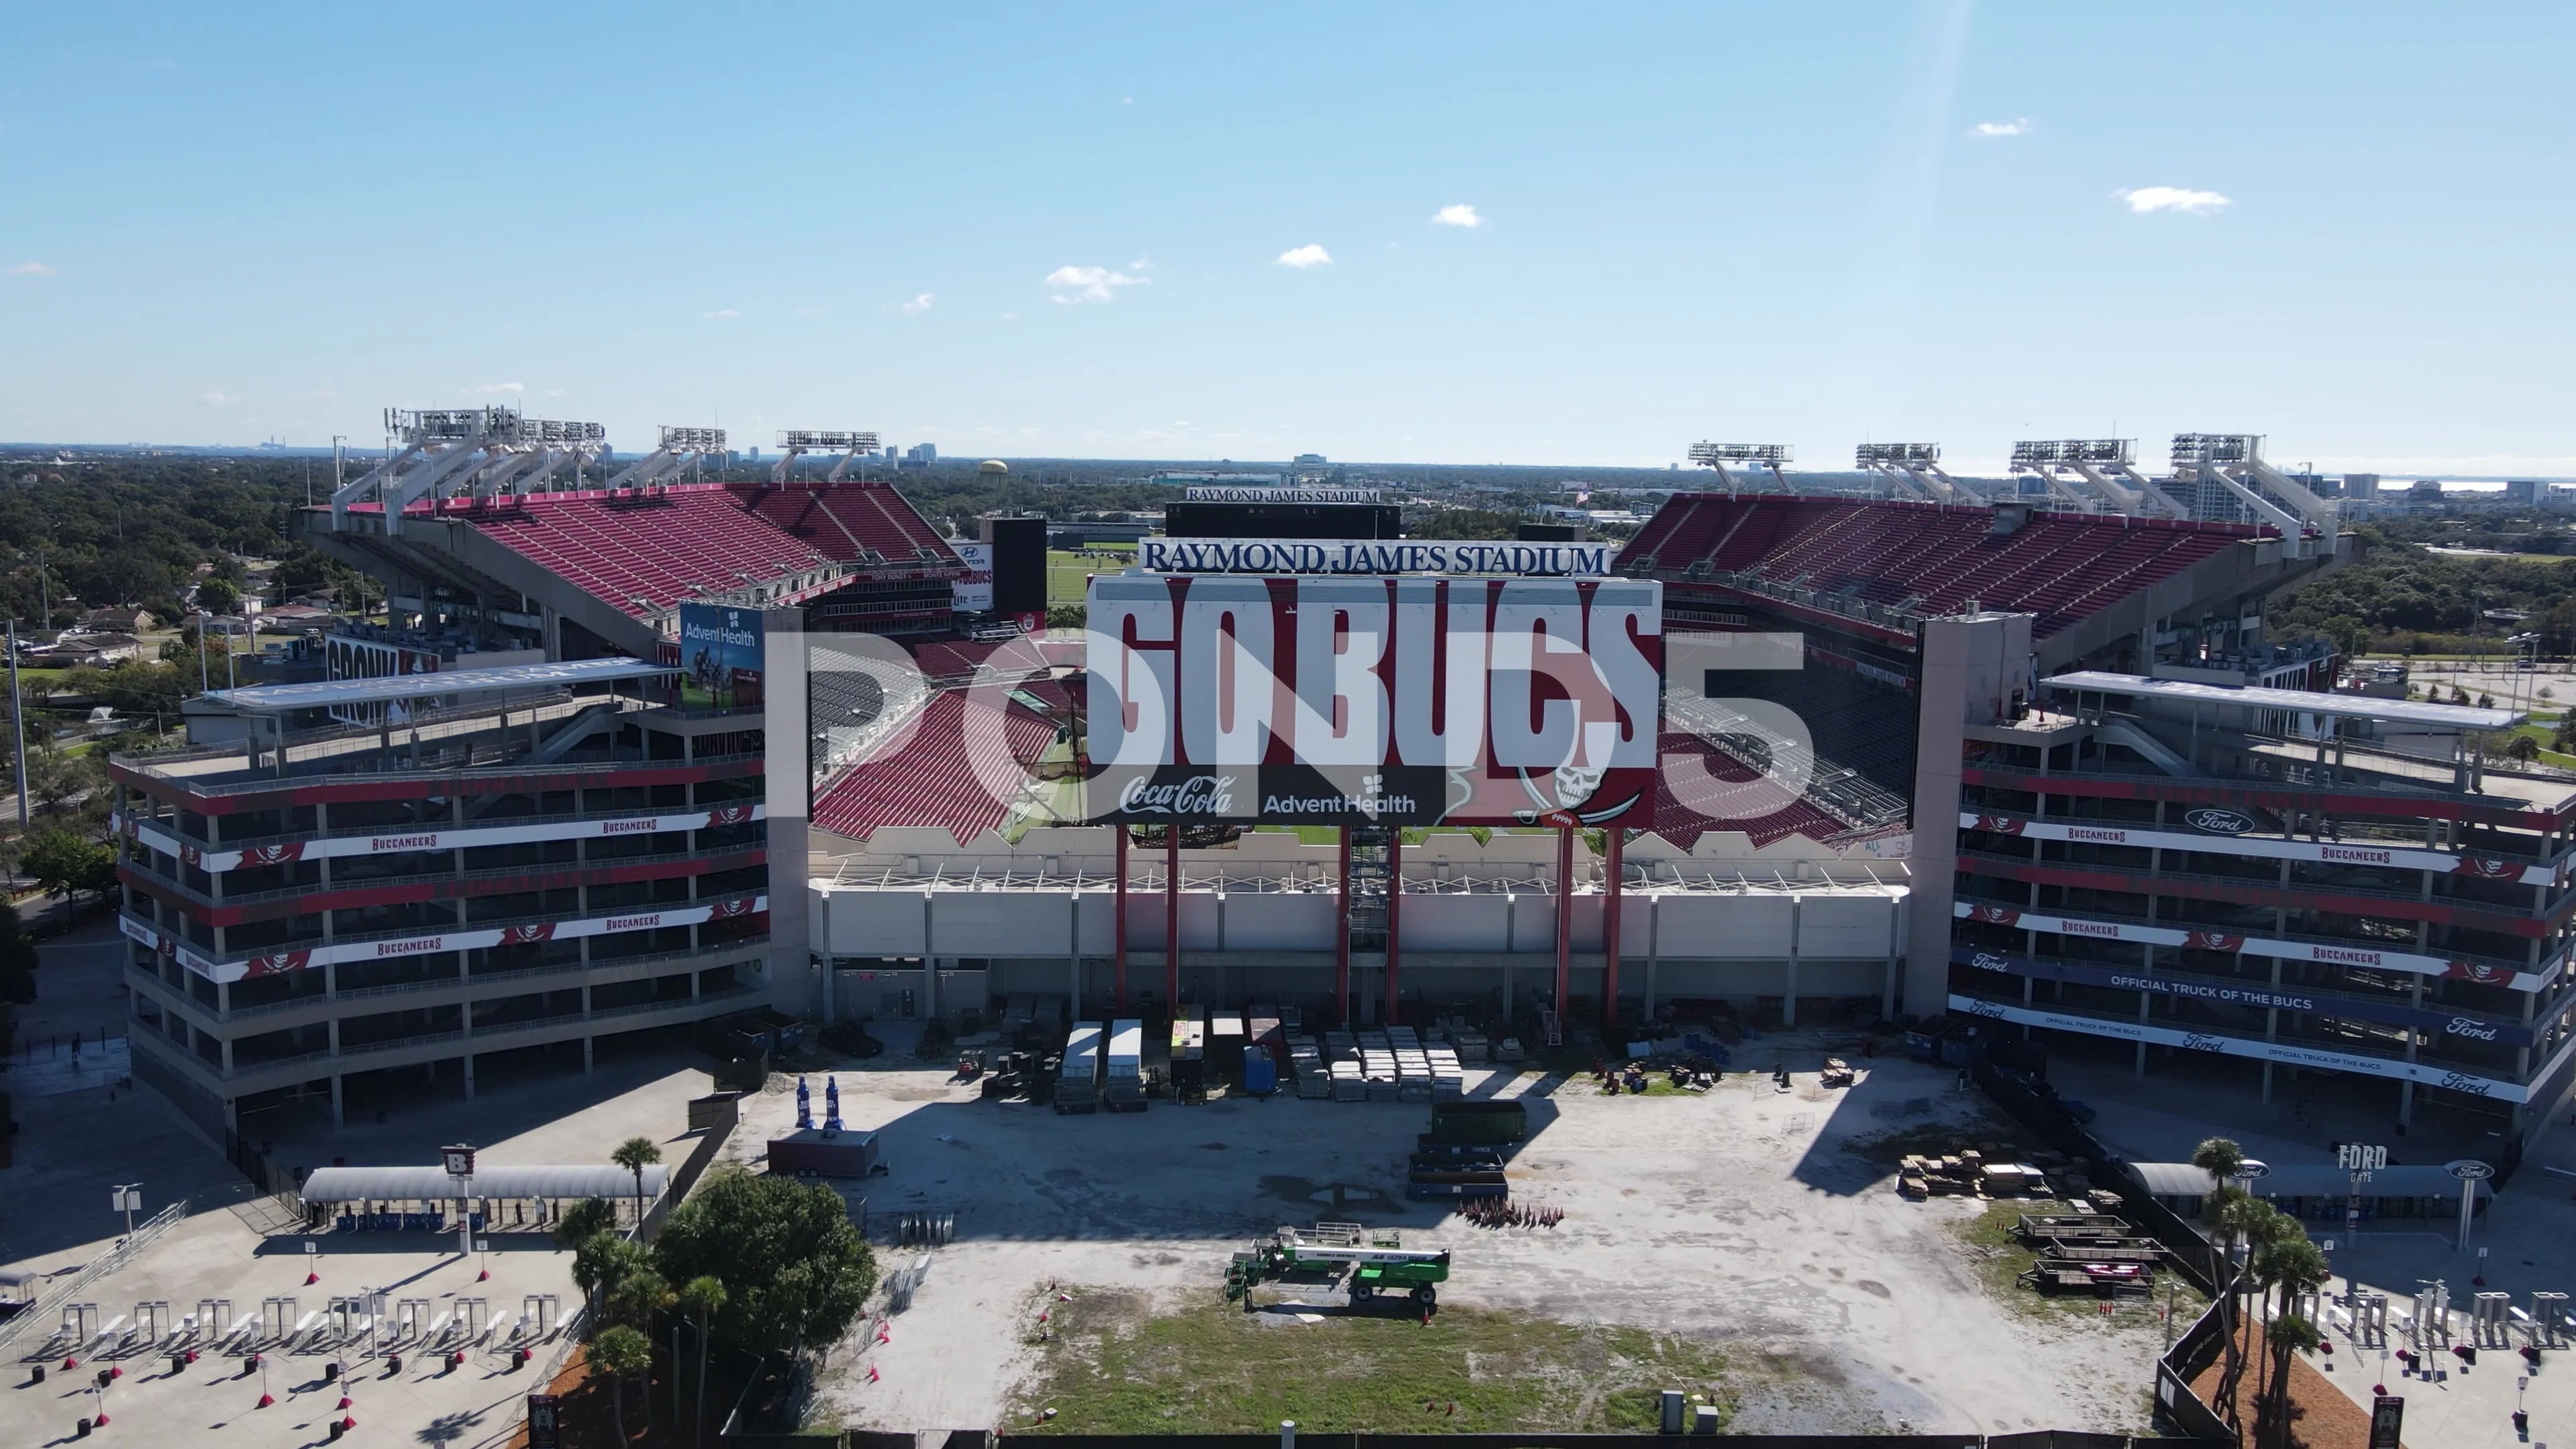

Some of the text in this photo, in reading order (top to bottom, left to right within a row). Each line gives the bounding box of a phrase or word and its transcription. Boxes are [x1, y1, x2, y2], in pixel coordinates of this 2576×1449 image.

[1188, 488, 1379, 503] RAYMOND JAMES STADIUM
[1144, 543, 1606, 574] RAYMOND JAMES STADIUM
[686, 623, 755, 647] AdventHealth
[1295, 579, 1660, 768] BUCS
[1120, 775, 1238, 814] Coca-Cola
[1263, 794, 1415, 814] AdventHealth
[604, 819, 657, 834] BUCCANEERS
[2198, 810, 2241, 833] Ford
[372, 835, 437, 851] BUCCANEERS
[2069, 828, 2125, 843] BUCCANEERS
[2322, 847, 2390, 864] BUCCANEERS
[606, 914, 659, 930] BUCCANEERS
[2062, 920, 2118, 936] BUCCANEERS
[378, 938, 441, 956] BUCCANEERS
[2313, 947, 2381, 966] BUCCANEERS
[1972, 953, 2008, 973] Ford
[2111, 976, 2312, 1010] OFFICIAL TRUCK OF THE BUCS
[1969, 1000, 2005, 1020] Ford
[2046, 1018, 2074, 1027] OFFICIAL
[2076, 1022, 2097, 1030] TRUCK
[2447, 1017, 2496, 1041] Ford
[2183, 1032, 2224, 1053] Ford
[2269, 1049, 2301, 1059] OFFICIAL
[2303, 1054, 2328, 1063] TRUCK
[2441, 1071, 2490, 1096] Ford
[447, 1154, 468, 1172] B
[2339, 1145, 2387, 1169] FORD
[2351, 1171, 2372, 1183] GATE
[2457, 1165, 2487, 1178] Ford
